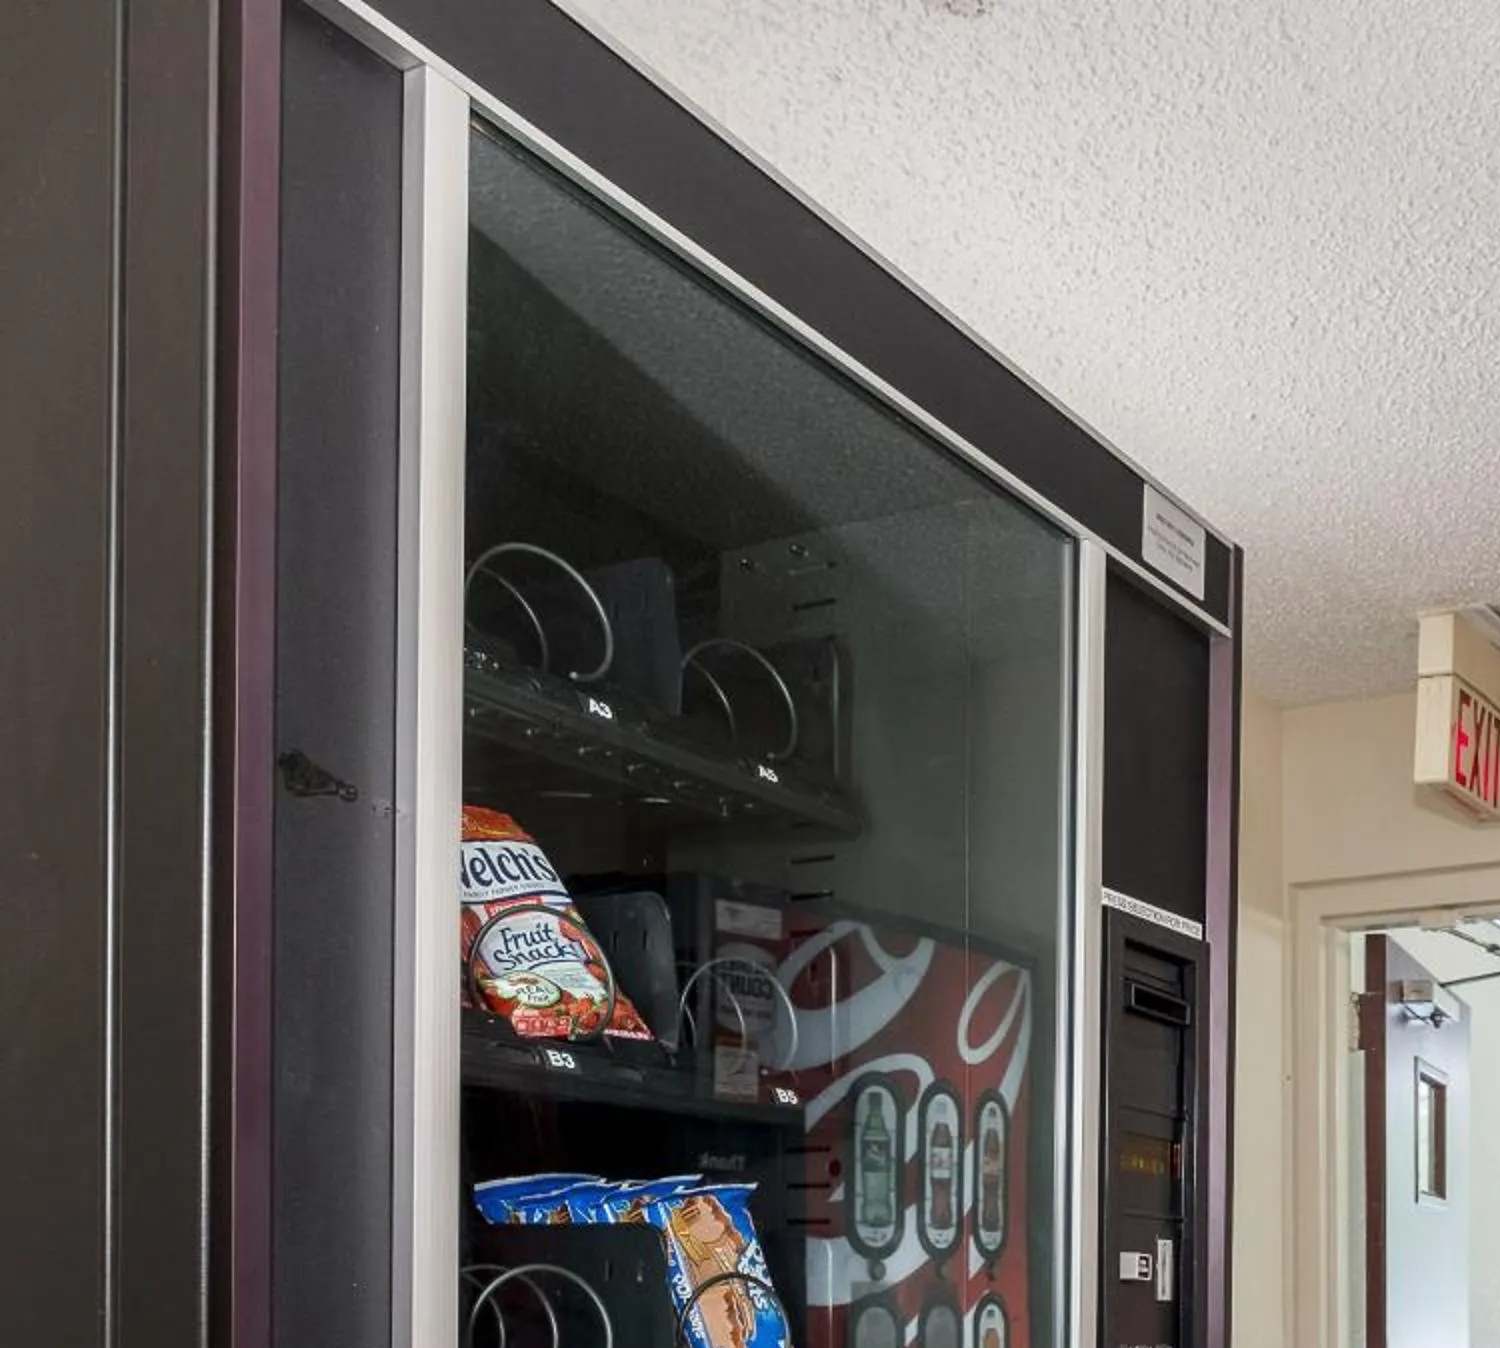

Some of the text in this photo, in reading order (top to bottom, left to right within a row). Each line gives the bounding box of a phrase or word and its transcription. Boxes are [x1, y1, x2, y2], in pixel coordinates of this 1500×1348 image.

[588, 698, 612, 720] A3
[501, 922, 554, 953] Fruit
[547, 1050, 576, 1069] B3
[775, 1087, 799, 1105] B5
